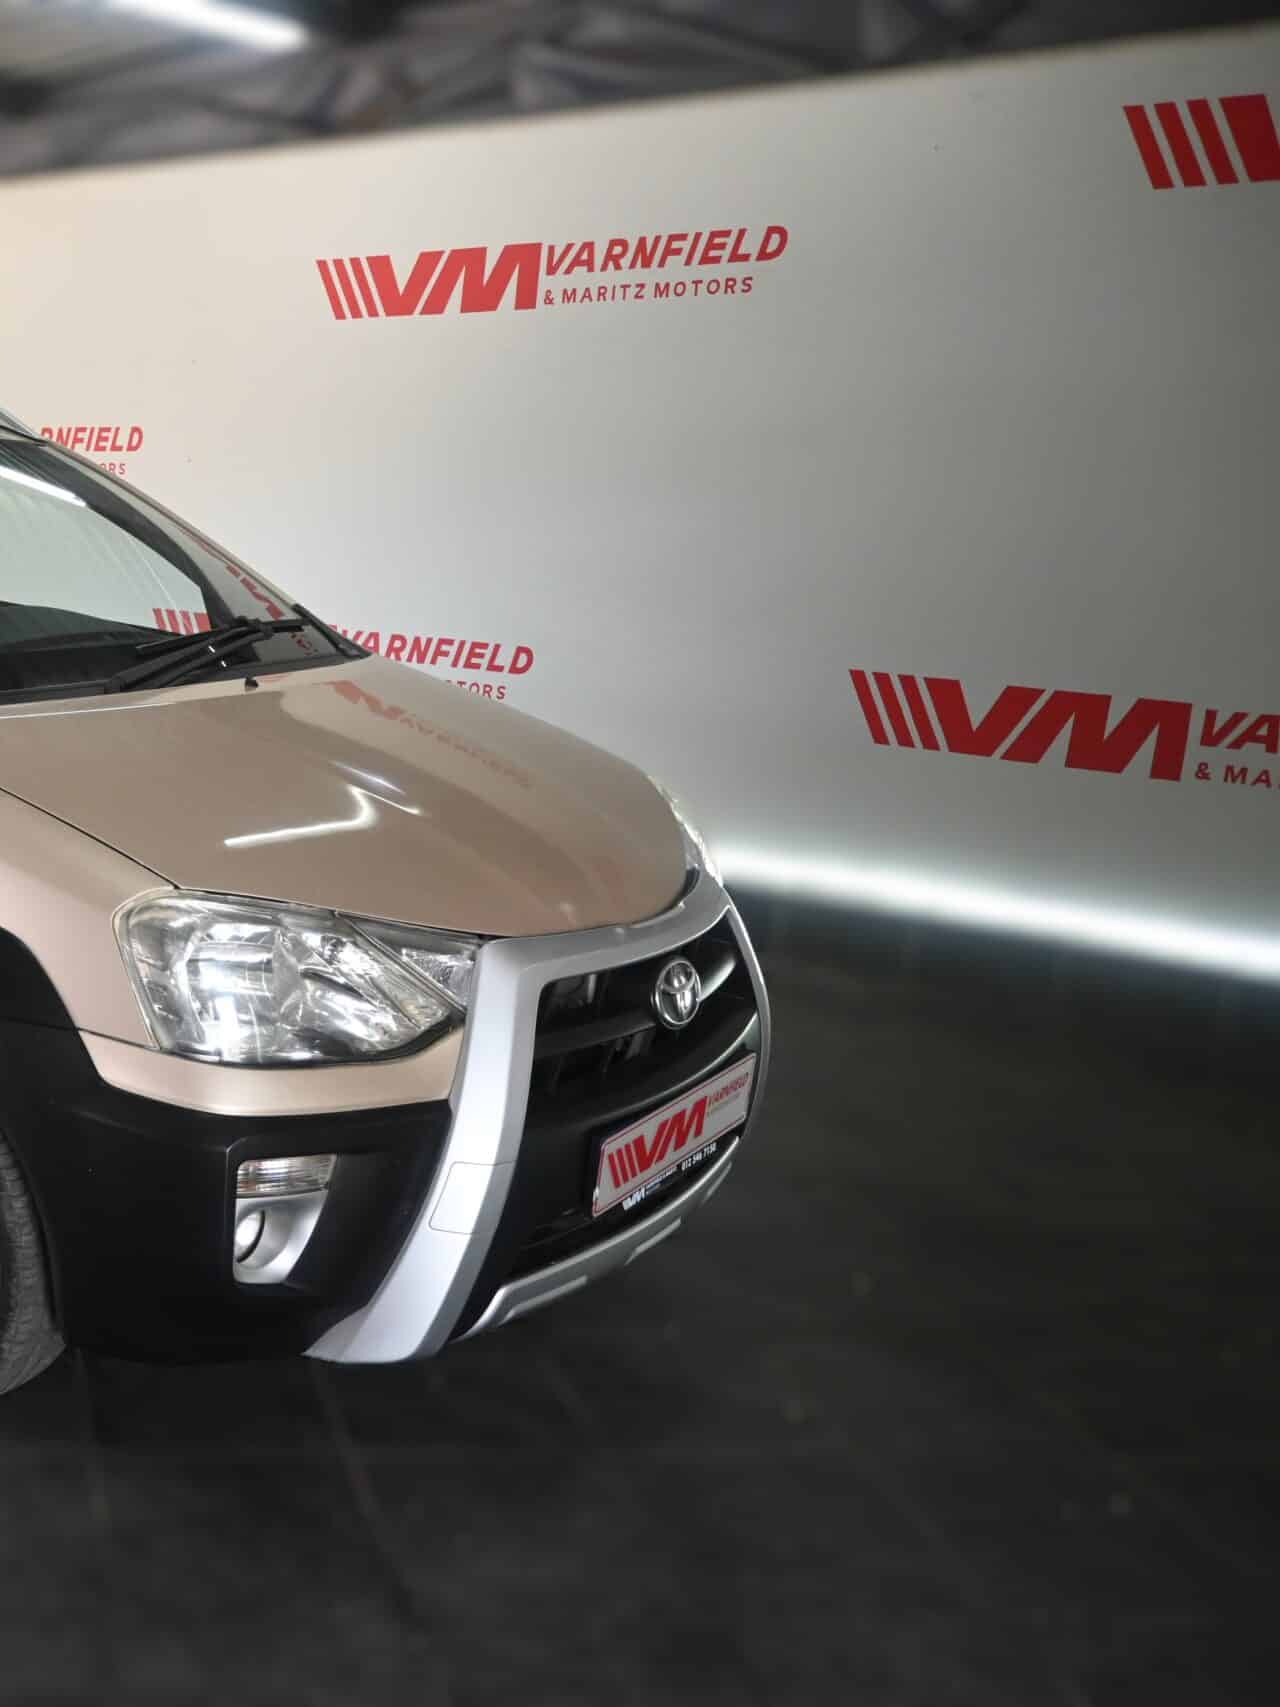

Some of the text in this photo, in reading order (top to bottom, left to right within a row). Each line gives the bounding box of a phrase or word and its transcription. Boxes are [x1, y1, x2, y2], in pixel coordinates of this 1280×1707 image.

[366, 242, 544, 318] VM
[544, 225, 789, 276] VARNFIELD
[543, 275, 754, 305] & MARITZ MOTORS
[923, 676, 1193, 782] VM
[1195, 762, 1212, 780] &
[632, 1095, 709, 1173] VM
